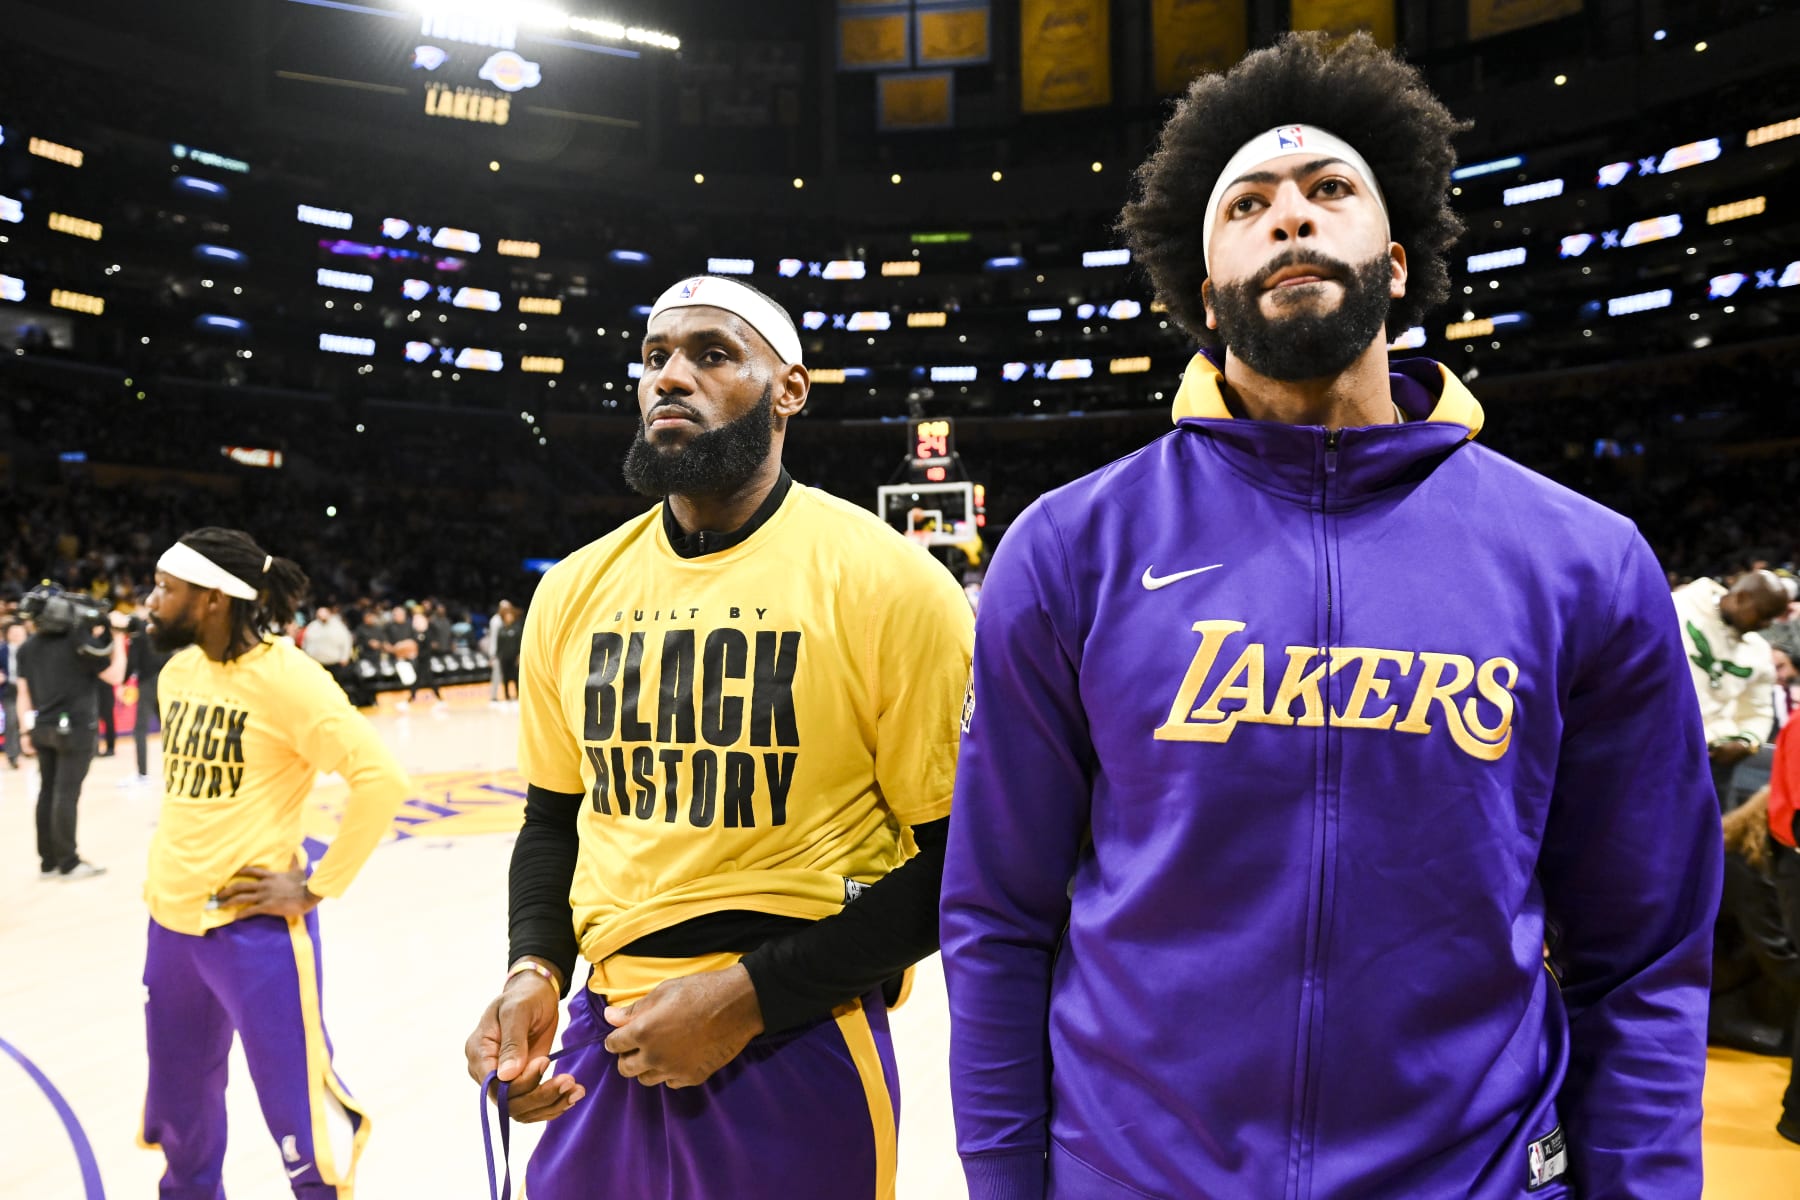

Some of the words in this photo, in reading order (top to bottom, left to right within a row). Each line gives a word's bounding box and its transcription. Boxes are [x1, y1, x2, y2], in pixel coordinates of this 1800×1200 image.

[614, 607, 699, 622] BUILT
[729, 606, 767, 620] BY
[583, 627, 802, 748] BLACK
[1152, 618, 1520, 762] LAKERS
[163, 756, 244, 799] STORY
[584, 745, 799, 829] HISTORY
